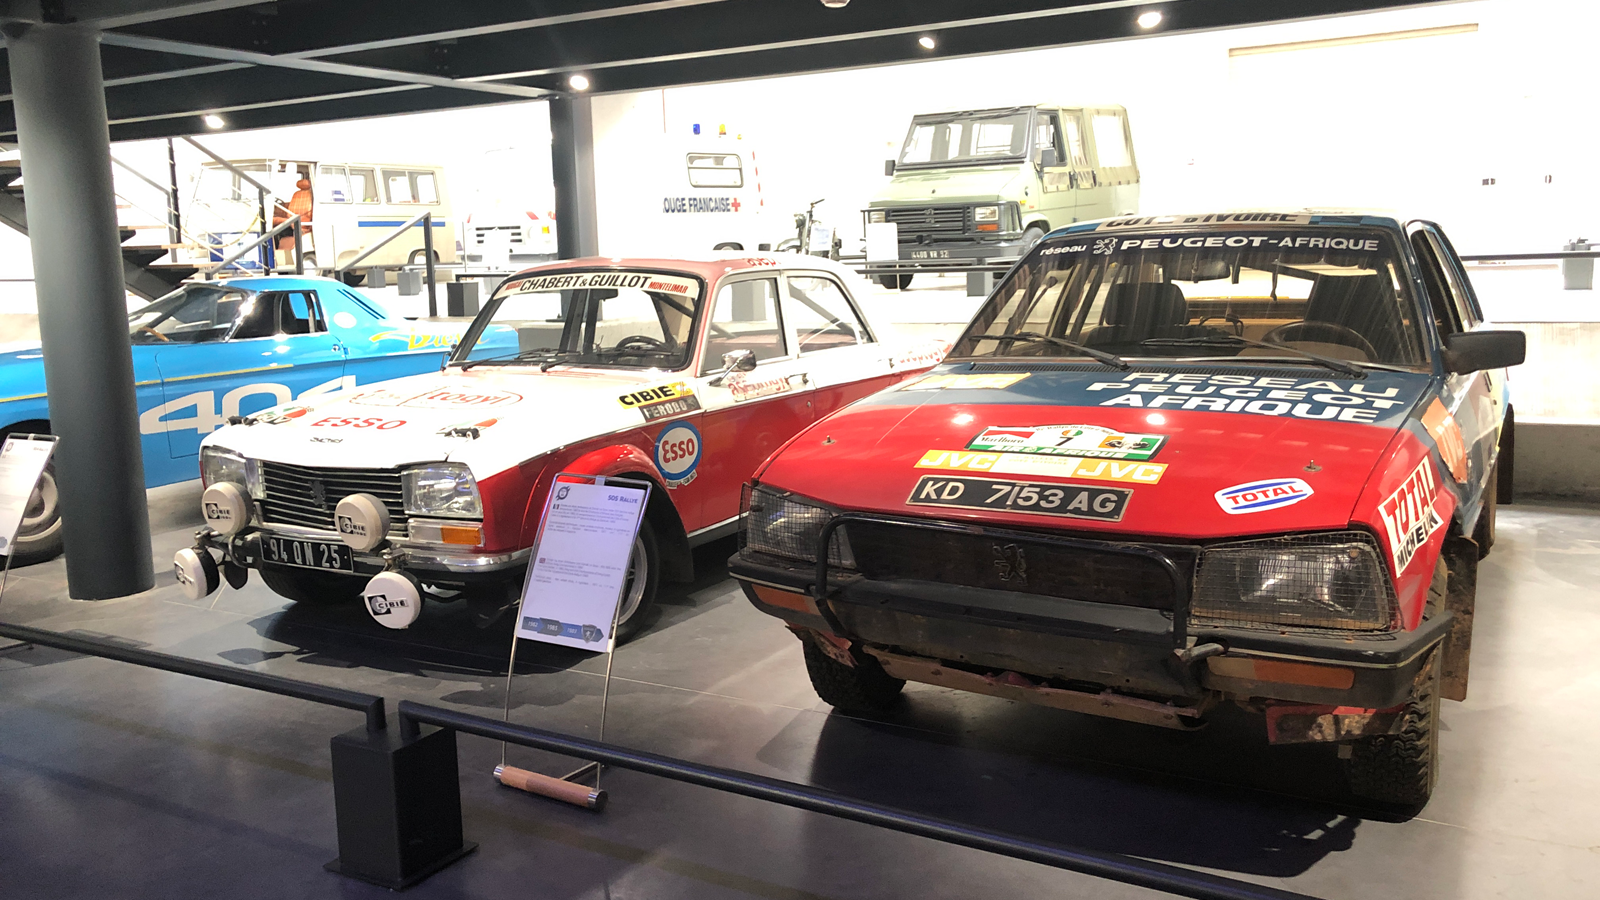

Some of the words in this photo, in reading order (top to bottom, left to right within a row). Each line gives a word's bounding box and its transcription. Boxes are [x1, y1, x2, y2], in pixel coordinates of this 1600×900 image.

[688, 197, 731, 213] FRANCAISE
[1039, 244, 1087, 256] réseau
[1120, 236, 1379, 251] PEUGEOT-AFRIQUE
[647, 281, 689, 294] MONTELIMAR
[1121, 372, 1401, 398] RESEAU
[619, 385, 676, 407] CIBIE
[1085, 382, 1405, 410] PEUGEOT
[643, 400, 689, 419] FERODO
[1098, 393, 1381, 424] AFRIQUE
[310, 416, 408, 431] ESSO
[1054, 436, 1075, 447] 7
[919, 452, 997, 471] JVC
[1039, 446, 1128, 459] AFRIQUE
[1076, 461, 1164, 482] JVC
[607, 494, 619, 502] SOS
[920, 479, 965, 501] KD
[1066, 490, 1119, 514] AG
[1226, 484, 1304, 506] TOTAL
[1384, 460, 1434, 545] TOTAL
[270, 537, 289, 562] 94
[293, 540, 316, 566] QN
[319, 543, 342, 569] 25
